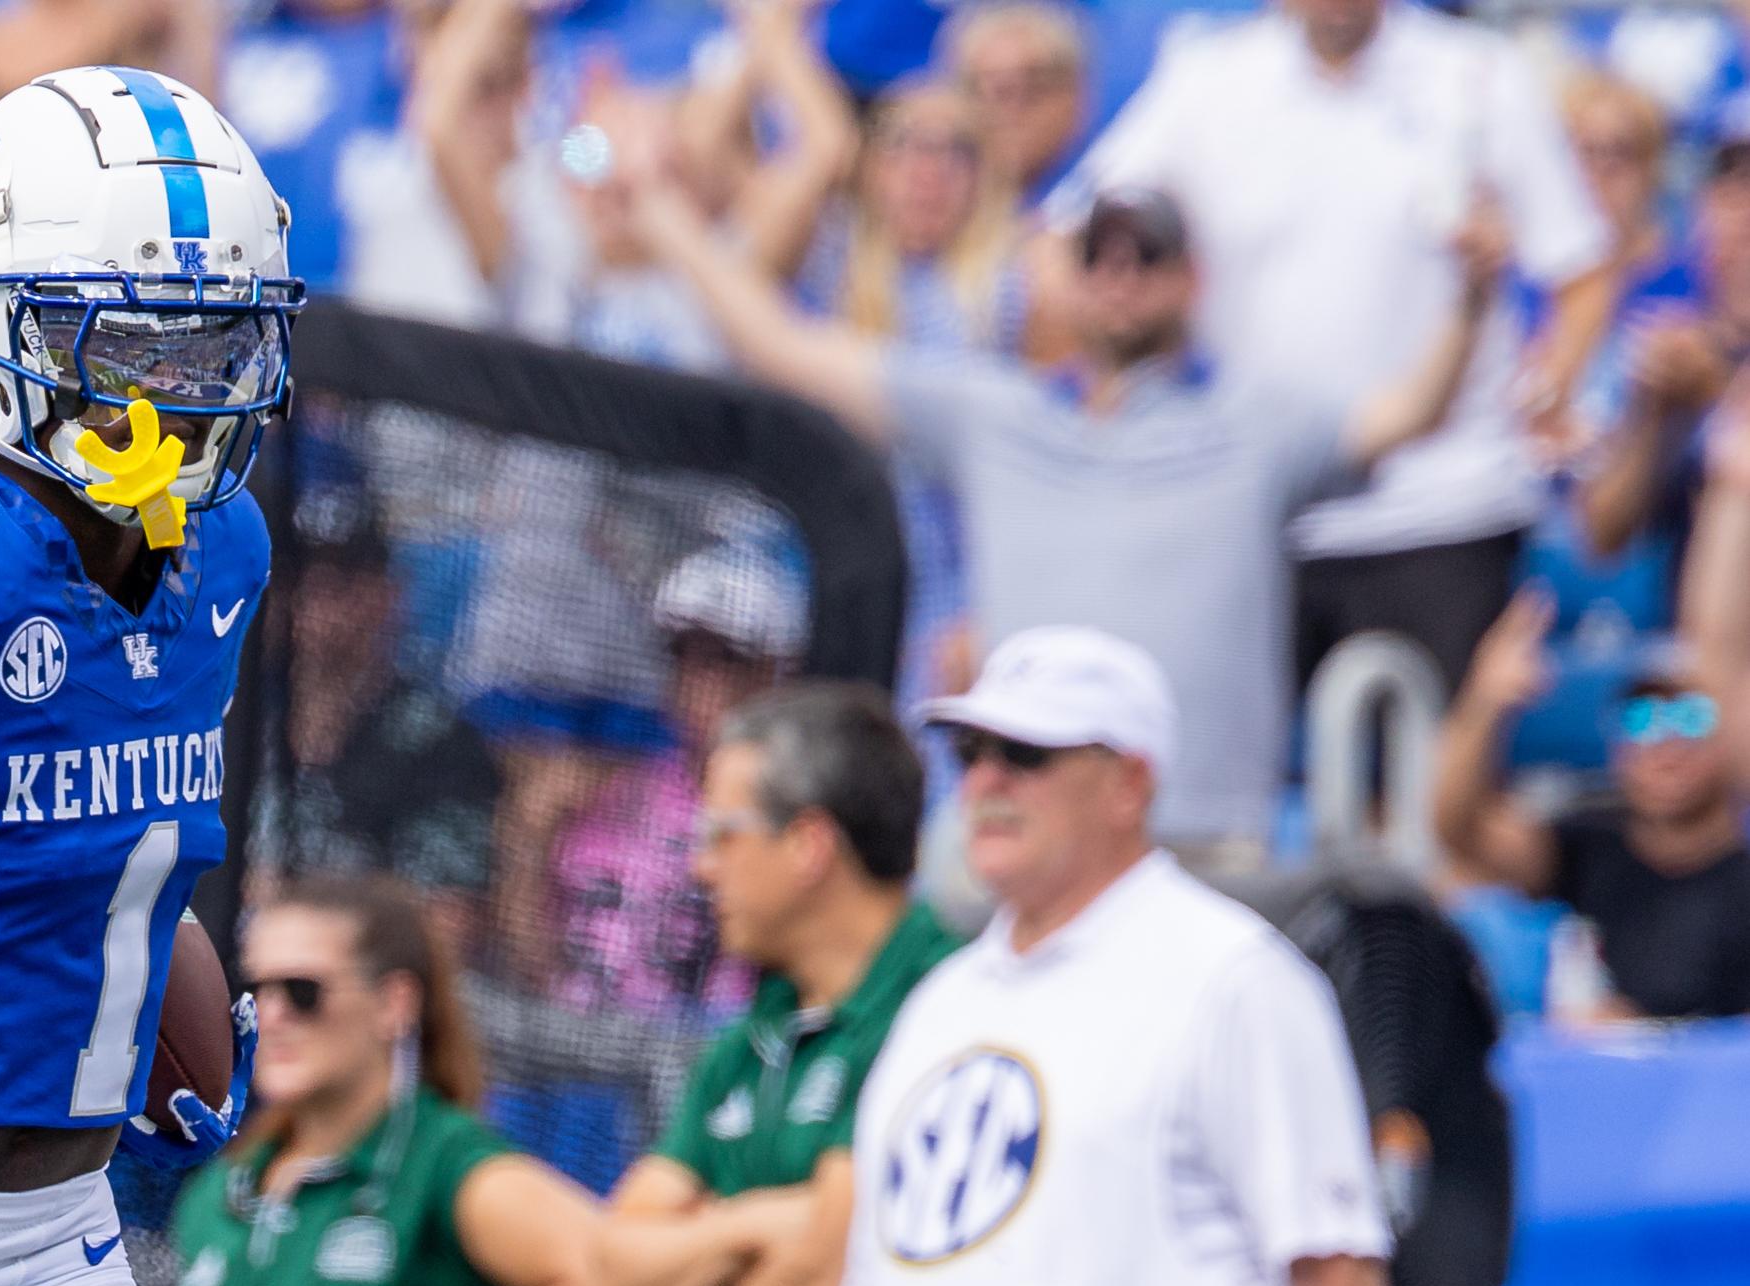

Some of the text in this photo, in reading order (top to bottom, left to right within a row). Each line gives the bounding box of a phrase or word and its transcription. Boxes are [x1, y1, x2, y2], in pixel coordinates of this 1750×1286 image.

[172, 241, 208, 273] UK
[9, 284, 50, 359] KETUCK
[4, 622, 62, 698] SEC
[122, 633, 160, 680] UK
[69, 820, 180, 1117] 1
